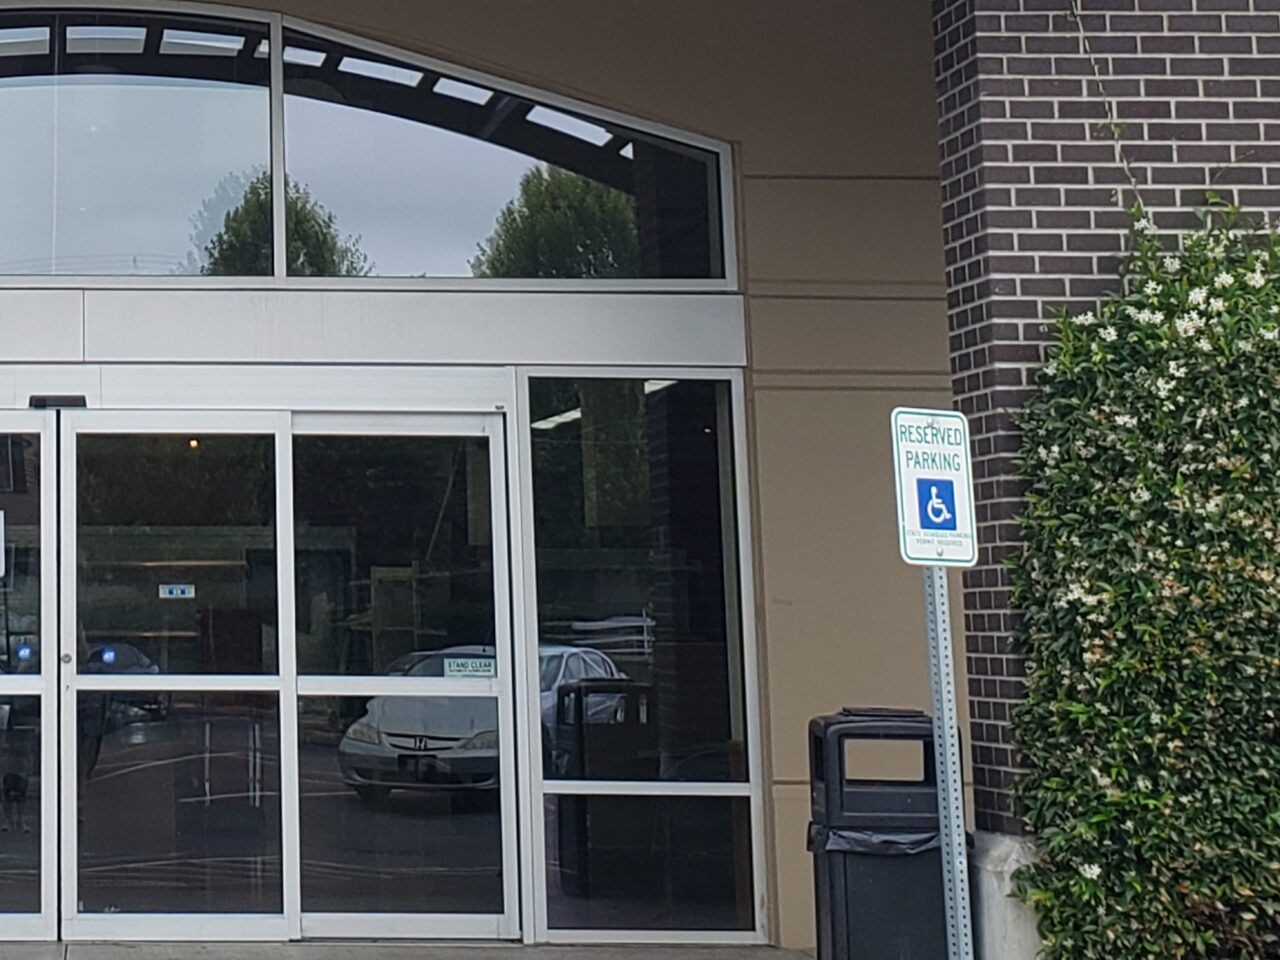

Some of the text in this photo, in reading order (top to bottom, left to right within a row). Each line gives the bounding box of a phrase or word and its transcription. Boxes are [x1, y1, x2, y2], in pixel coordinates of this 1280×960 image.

[899, 424, 962, 446] RESERVED
[905, 450, 961, 472] PARKING
[448, 661, 492, 669] STAND CLEAR
